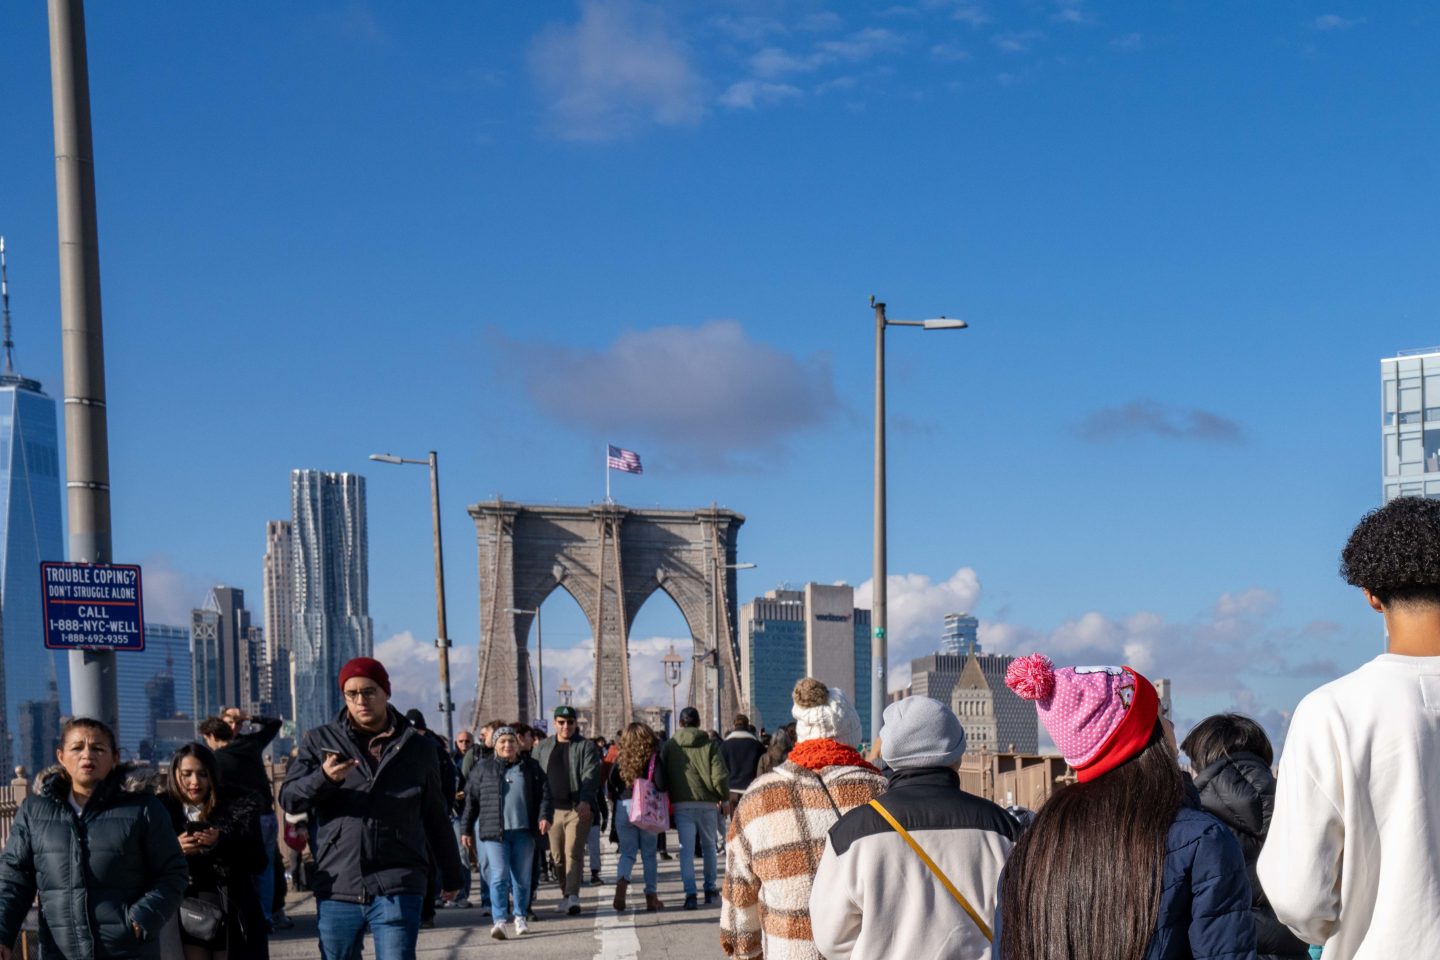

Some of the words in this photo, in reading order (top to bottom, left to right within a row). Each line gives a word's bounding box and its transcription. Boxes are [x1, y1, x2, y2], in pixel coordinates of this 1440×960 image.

[46, 568, 91, 583] TROUBLE
[94, 570, 136, 584] COPING?
[49, 585, 71, 597] DON'T
[74, 586, 110, 599] STRUGGLE
[112, 588, 136, 599] ALONE
[78, 606, 109, 618] CALL
[50, 619, 138, 633] 1-888-NYC-WELL
[61, 634, 129, 643] 1-888-692-9355
